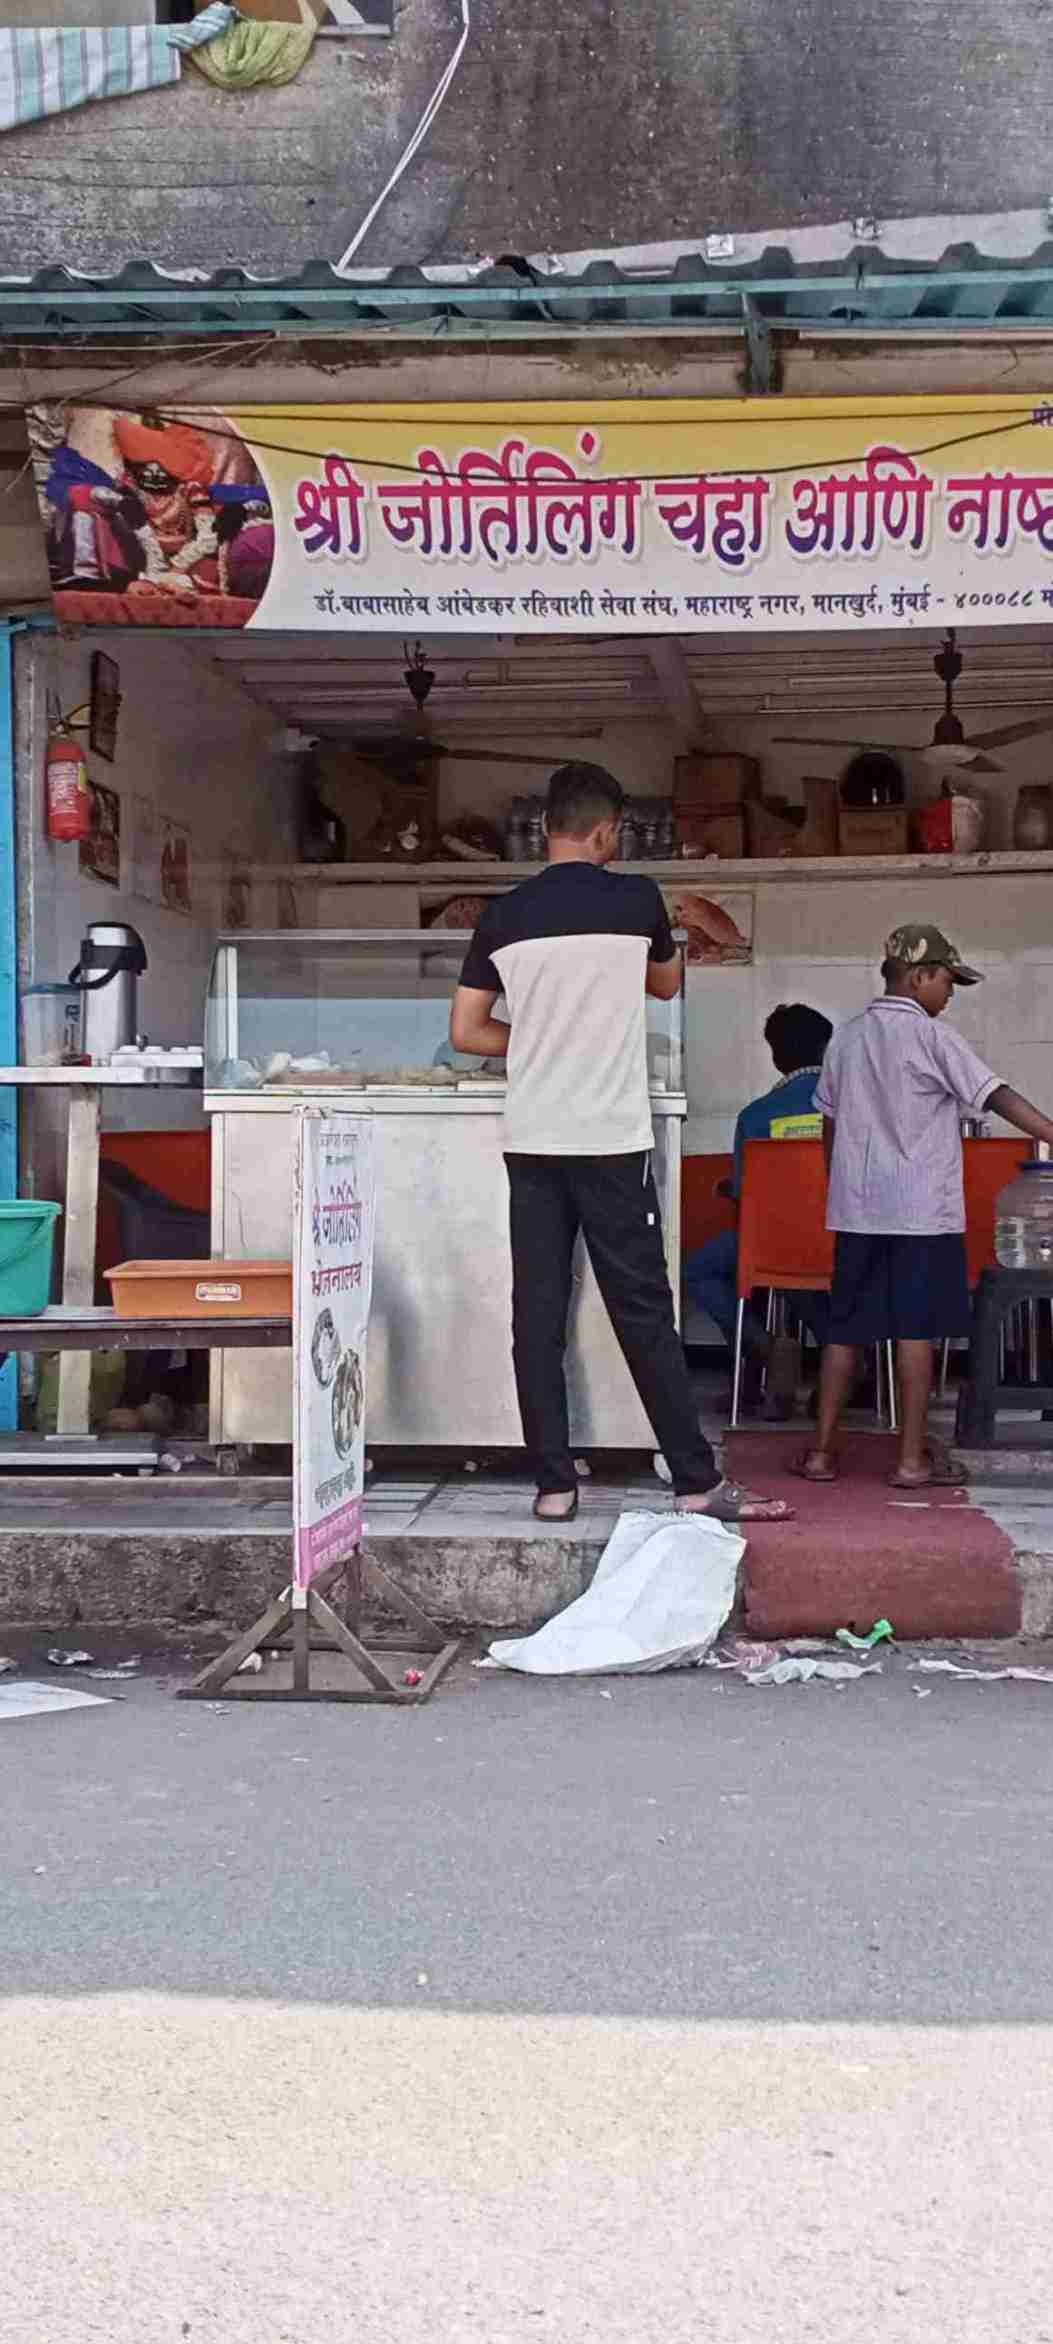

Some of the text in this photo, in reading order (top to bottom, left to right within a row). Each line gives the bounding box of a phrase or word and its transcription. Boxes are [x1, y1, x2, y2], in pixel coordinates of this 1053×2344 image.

[295, 453, 365, 555] श्री
[654, 474, 770, 567] चहा
[785, 446, 935, 553] आणि
[437, 588, 514, 617] आंबेडकर
[521, 588, 595, 617] रहिवाशी
[600, 588, 636, 616] सेवा
[641, 589, 678, 617] संघ,
[684, 592, 753, 619] महाराष्ट्र
[758, 593, 805, 615] नगर,
[811, 585, 883, 618] मानखुर्द,
[890, 584, 931, 617] मुंबई
[951, 589, 1034, 610] ४०००८८
